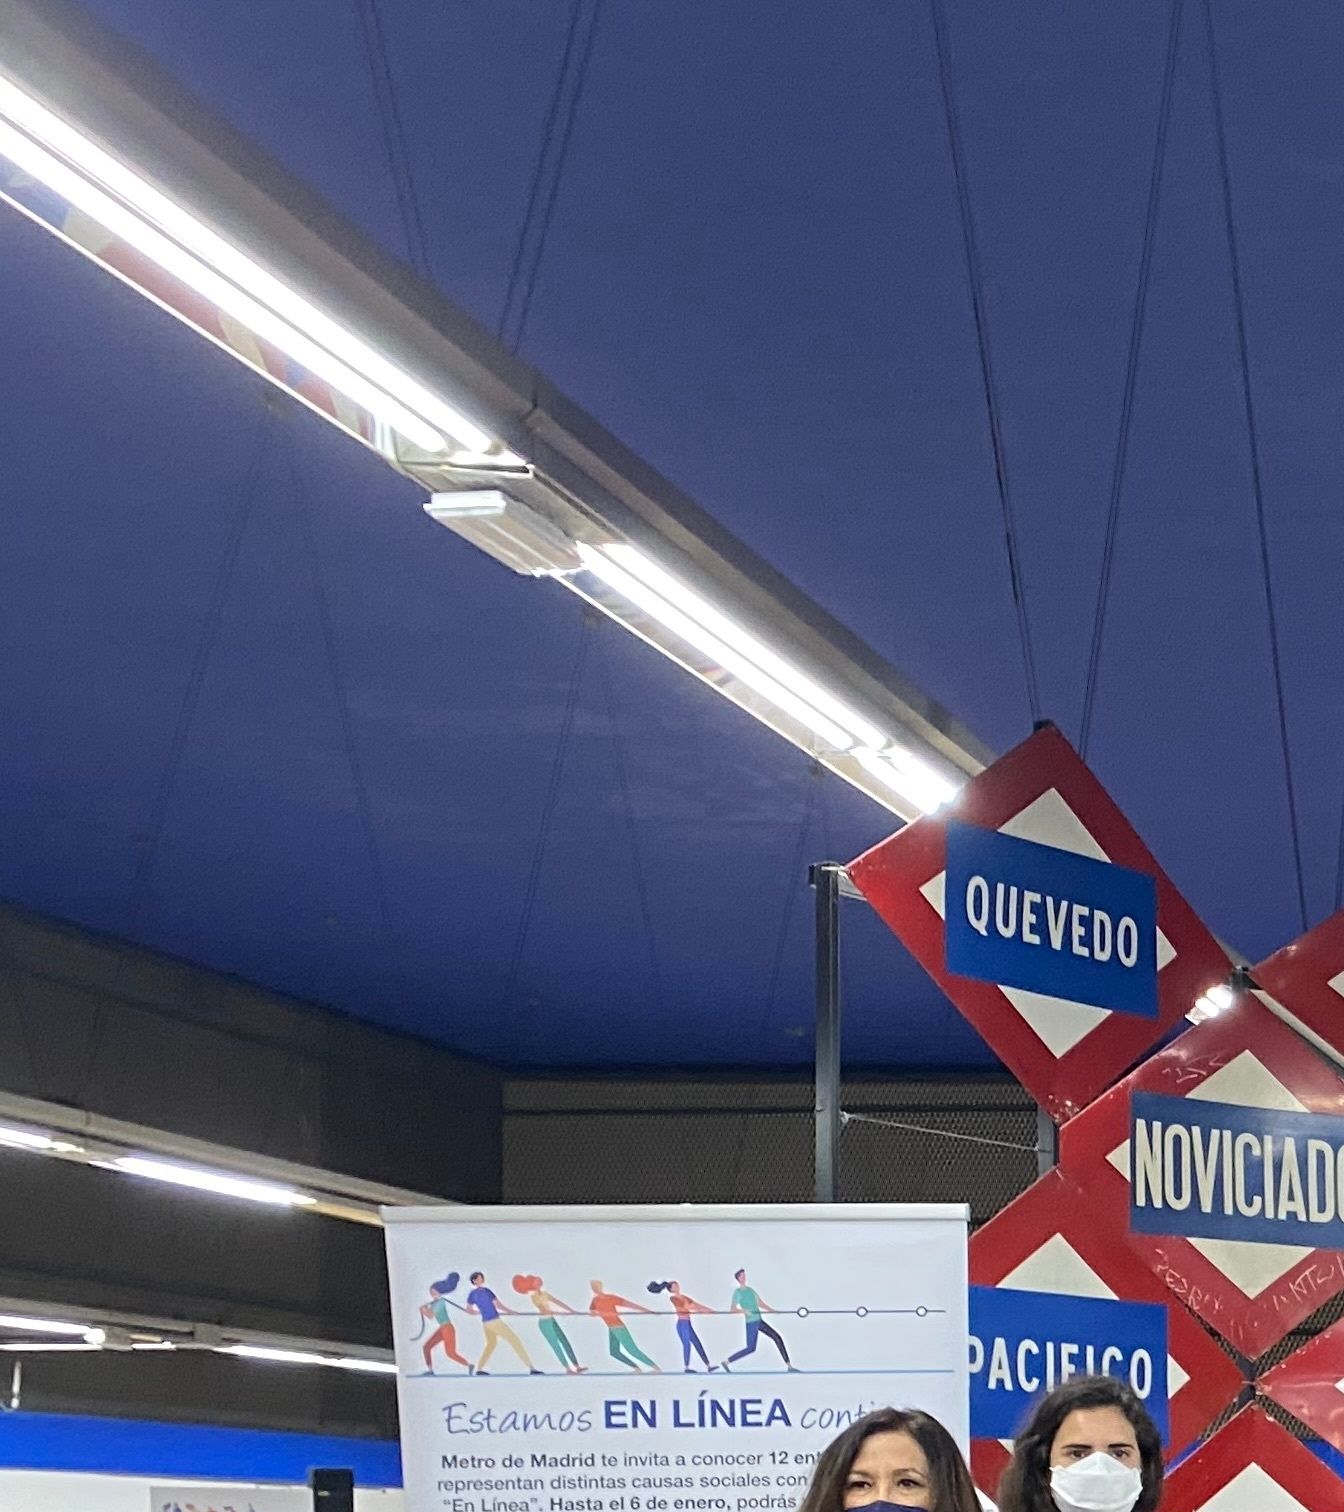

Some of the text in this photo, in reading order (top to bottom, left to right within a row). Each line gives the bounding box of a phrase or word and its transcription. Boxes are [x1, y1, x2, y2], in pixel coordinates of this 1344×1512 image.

[965, 875, 1139, 968] QUEVEDO
[442, 1401, 593, 1435] Estamos
[604, 1399, 657, 1430] EN
[672, 1389, 792, 1430] LÍNEA
[441, 1454, 496, 1469] Metro
[501, 1453, 525, 1469] de
[530, 1452, 596, 1468] Madrid
[601, 1453, 618, 1467] te
[623, 1452, 670, 1467] invita
[675, 1455, 686, 1467] a
[691, 1454, 764, 1467] conocer
[769, 1451, 789, 1465] 12
[437, 1477, 545, 1495] representan
[550, 1475, 627, 1490] distintas
[631, 1477, 694, 1489] causas
[699, 1473, 771, 1488] sociales
[550, 1496, 603, 1512] Hasta
[609, 1496, 625, 1511] el
[630, 1496, 641, 1511] 6
[646, 1495, 668, 1511] de
[673, 1497, 732, 1512] enero,
[736, 1494, 797, 1512] podrás
